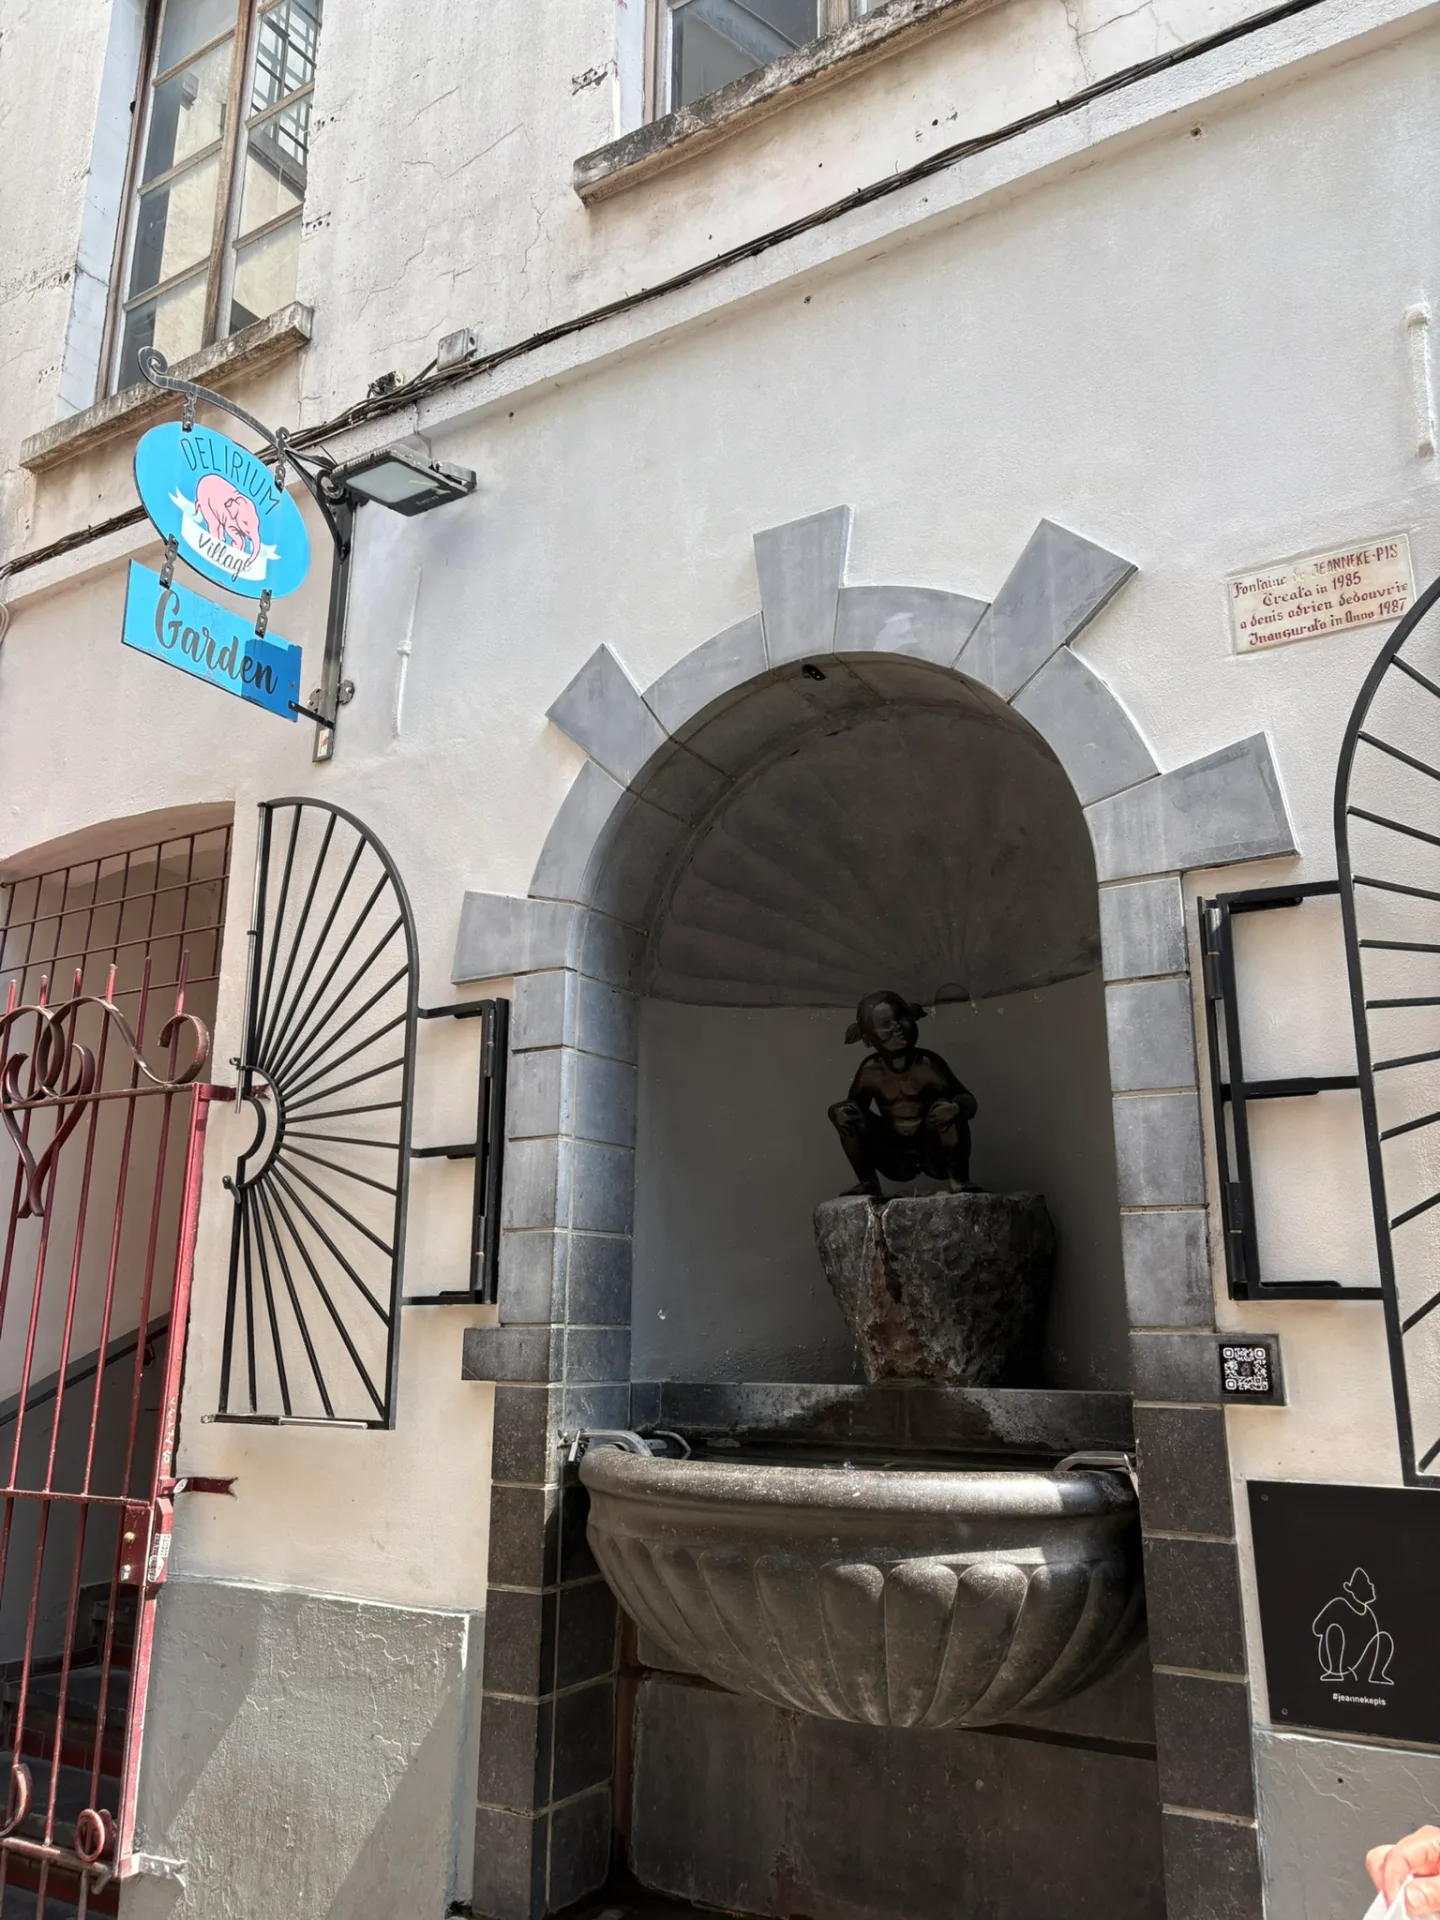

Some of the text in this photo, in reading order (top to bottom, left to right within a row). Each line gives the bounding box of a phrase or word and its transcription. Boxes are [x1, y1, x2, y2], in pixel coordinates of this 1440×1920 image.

[180, 437, 280, 514] DELIRIUM
[198, 533, 251, 583] Village
[1312, 544, 1398, 577] JEANNEKE-PIS
[1262, 572, 1362, 606] Creata in 1985
[1240, 621, 1247, 630] a
[1331, 614, 1342, 626] in
[1378, 597, 1407, 616] 1987
[155, 590, 278, 695] Garden
[1332, 1693, 1386, 1706] #jeannekepis
